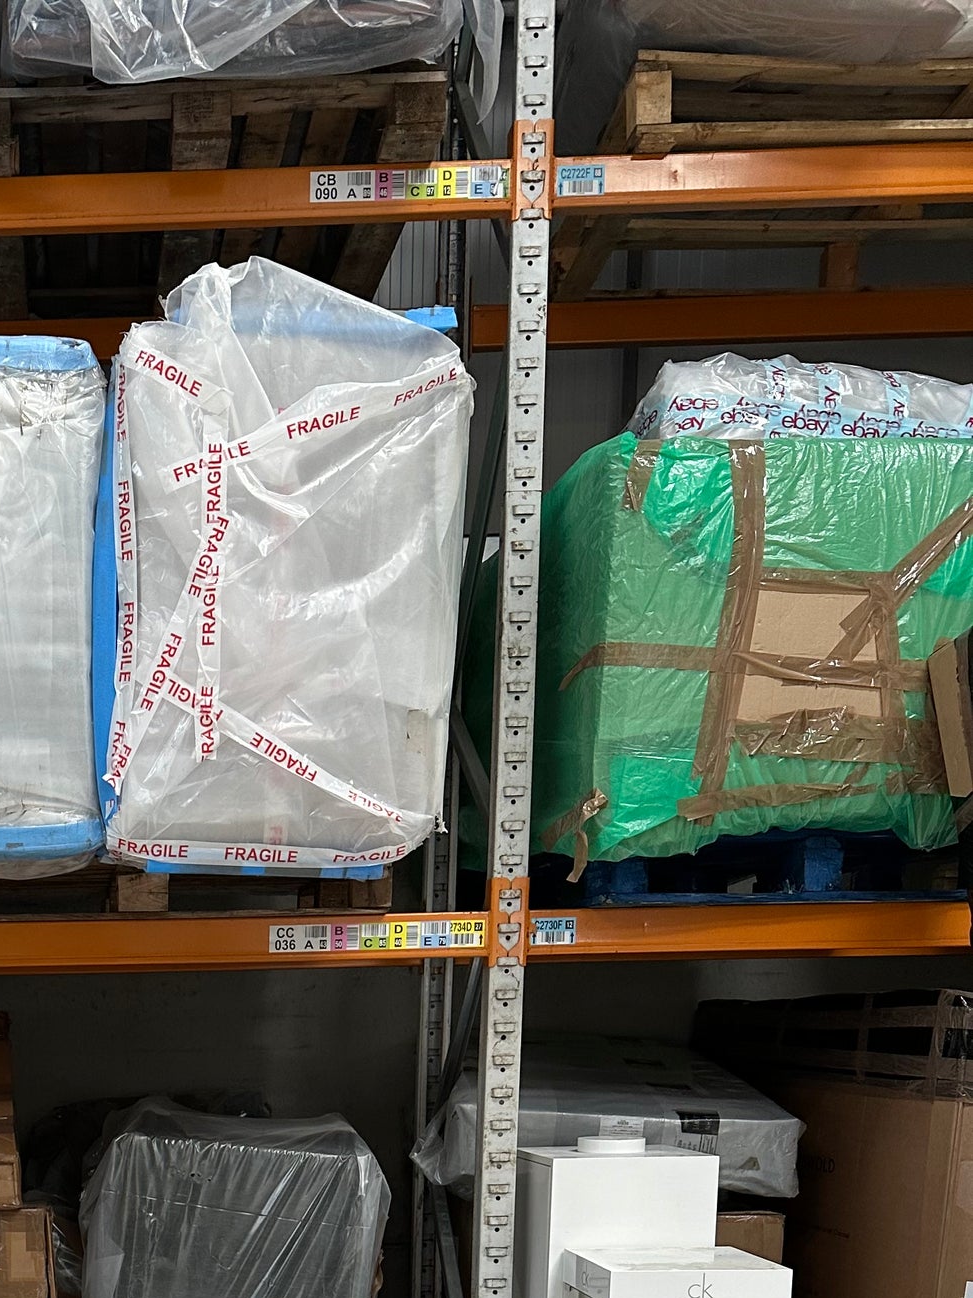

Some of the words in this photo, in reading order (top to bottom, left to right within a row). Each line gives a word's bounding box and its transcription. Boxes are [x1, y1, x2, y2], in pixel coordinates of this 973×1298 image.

[379, 172, 388, 183] B
[443, 170, 452, 181] D
[560, 167, 591, 179] C2722F
[317, 174, 336, 187] CB
[315, 187, 338, 200] 090
[347, 188, 357, 198] A
[410, 186, 420, 196] C
[443, 185, 451, 196] 12
[474, 184, 483, 195] E
[135, 350, 203, 397] FRAGILE
[393, 367, 457, 407] FRAGILE
[286, 406, 361, 440] FRAGILE
[782, 412, 830, 435] ebay
[206, 443, 223, 525] FRAGILE
[118, 480, 133, 562] FRAGILE
[188, 516, 230, 598] FRAGILE
[119, 601, 135, 683] FRAGILE
[140, 633, 183, 712] FRAGILE
[250, 732, 318, 782] FRAGILE
[117, 838, 189, 858] FRAGILE
[333, 845, 407, 863] FRAGILE
[224, 847, 299, 863] FRAGILE
[277, 927, 294, 939] CC
[335, 926, 343, 936] B
[394, 924, 403, 934] D
[474, 922, 483, 932] 27
[274, 938, 297, 951] 036
[304, 940, 314, 949] A
[363, 938, 373, 948] C
[424, 936, 432, 946] E
